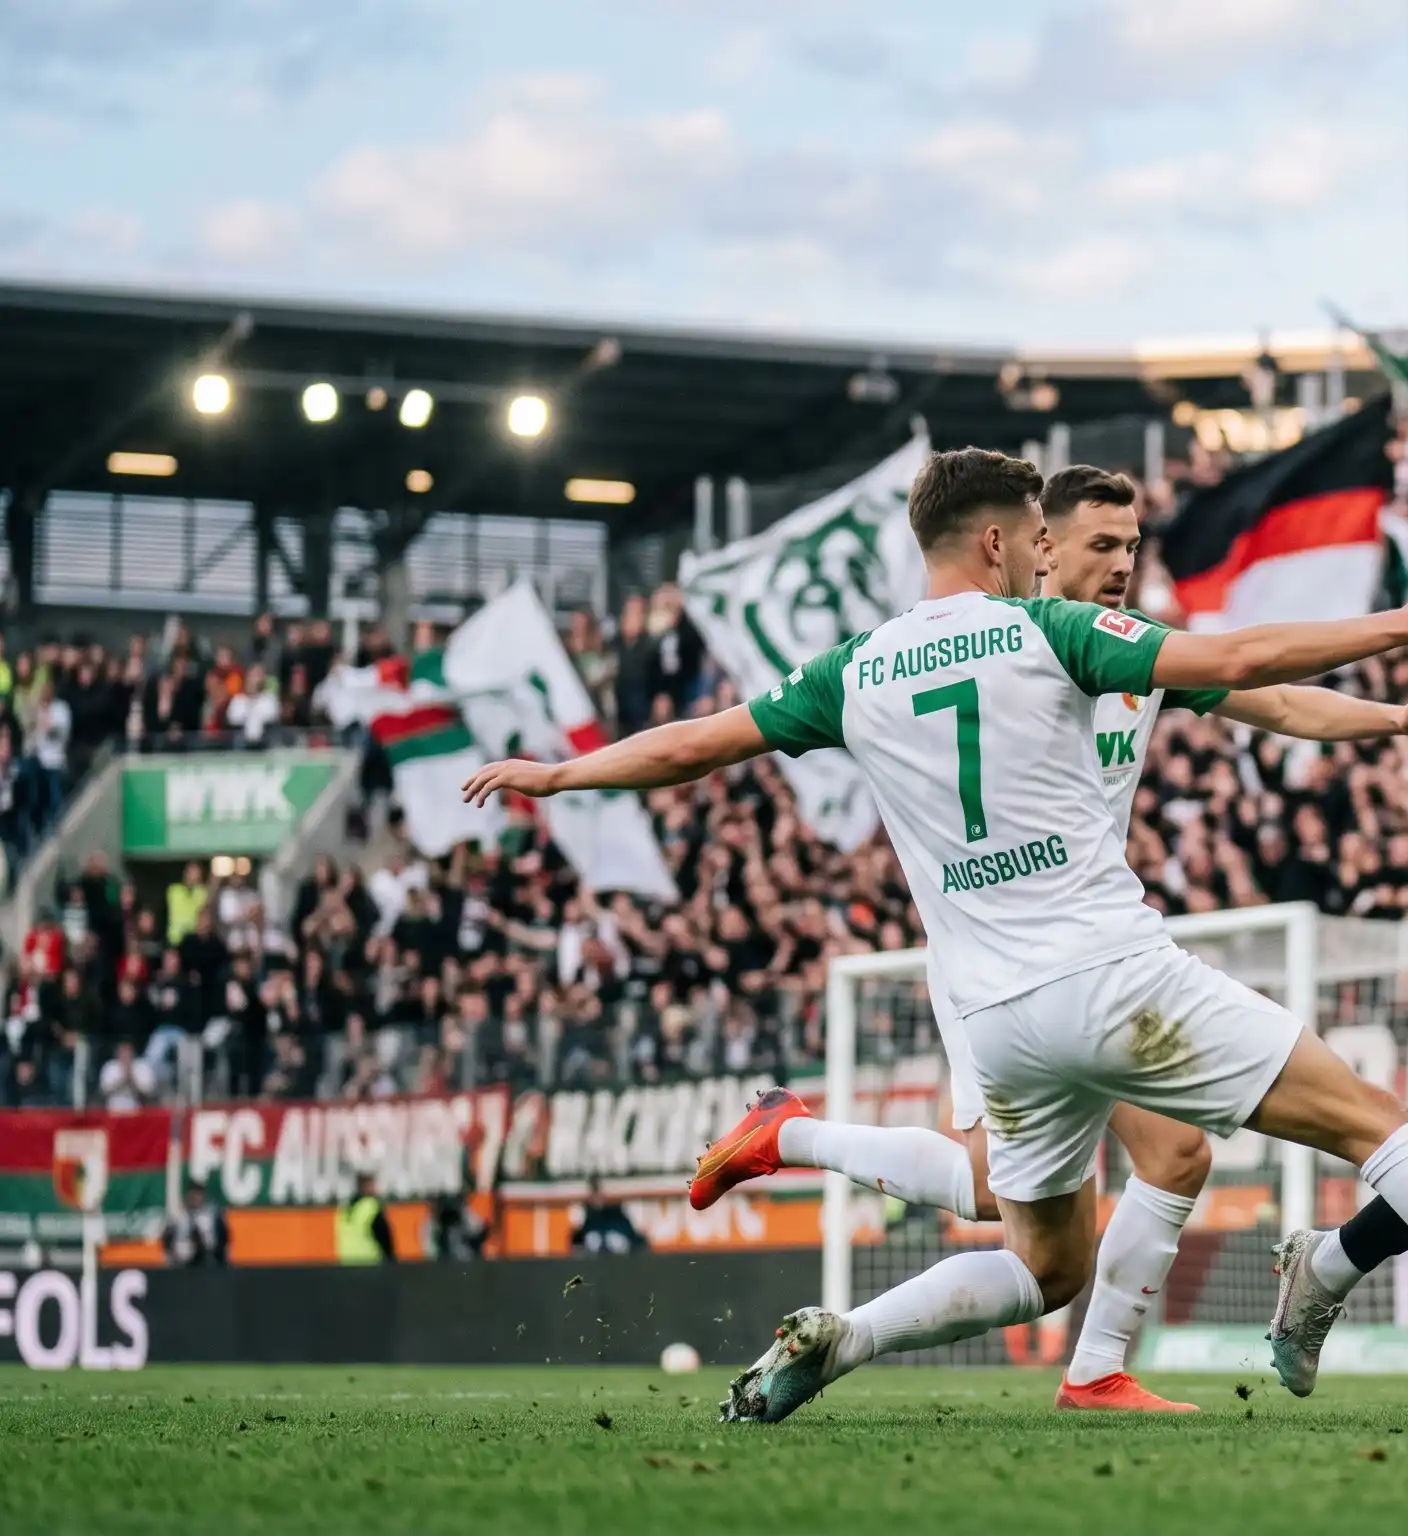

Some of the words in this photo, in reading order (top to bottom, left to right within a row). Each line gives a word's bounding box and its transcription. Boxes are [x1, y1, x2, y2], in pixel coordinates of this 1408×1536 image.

[858, 656, 885, 690] FC
[892, 624, 1023, 681] AUGSBURG
[911, 677, 988, 844] 7
[942, 834, 1069, 894] AUGSBURG
[190, 1107, 264, 1205] FC
